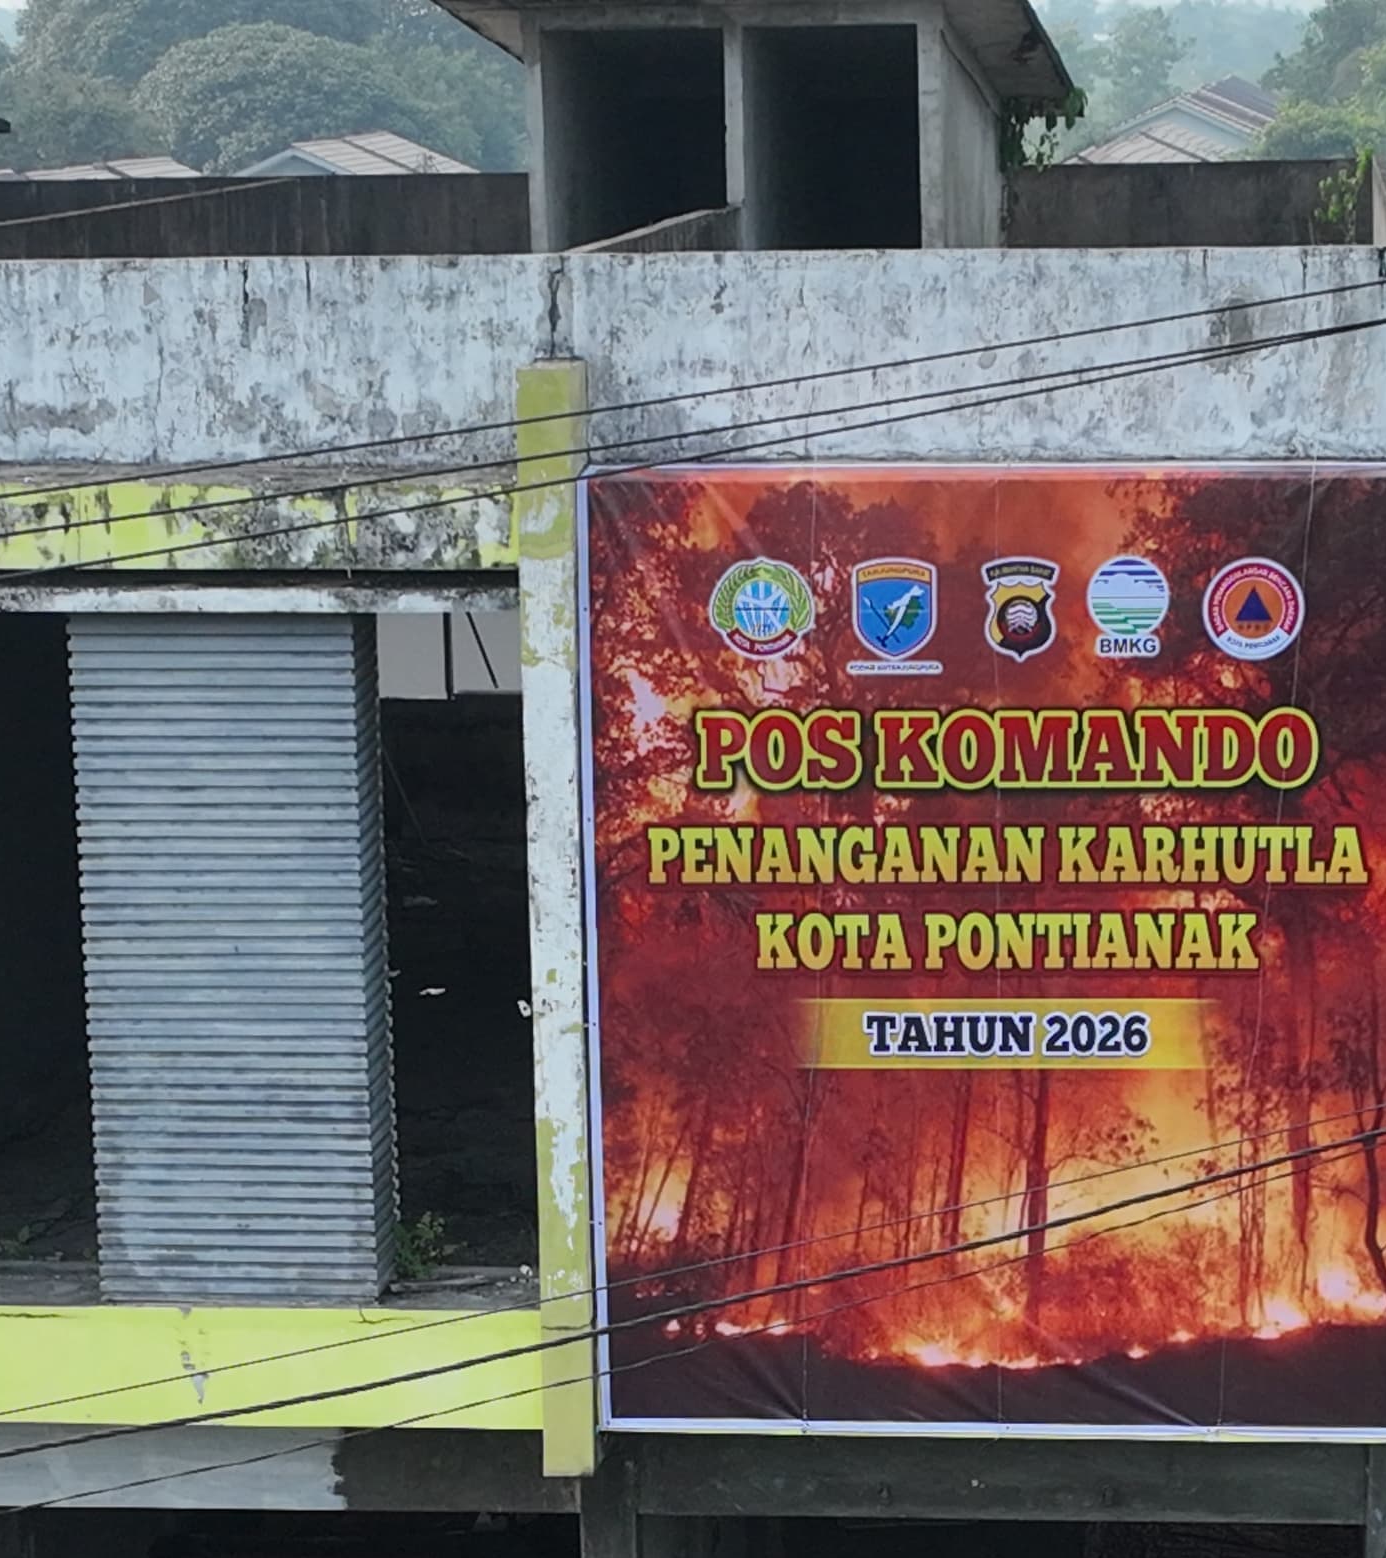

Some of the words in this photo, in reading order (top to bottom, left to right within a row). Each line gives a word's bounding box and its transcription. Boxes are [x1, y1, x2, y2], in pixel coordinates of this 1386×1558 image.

[1100, 638, 1157, 654] BMKG
[699, 711, 859, 788] POS
[876, 708, 1319, 788] KOMANDO
[648, 827, 1044, 885] PENANGANAN
[1059, 826, 1369, 885] KARHUTLA
[756, 914, 912, 971] KOTA
[925, 912, 1260, 971] PONTIANAK
[866, 1014, 1033, 1055] TAHUN
[1044, 1013, 1149, 1054] 2026
